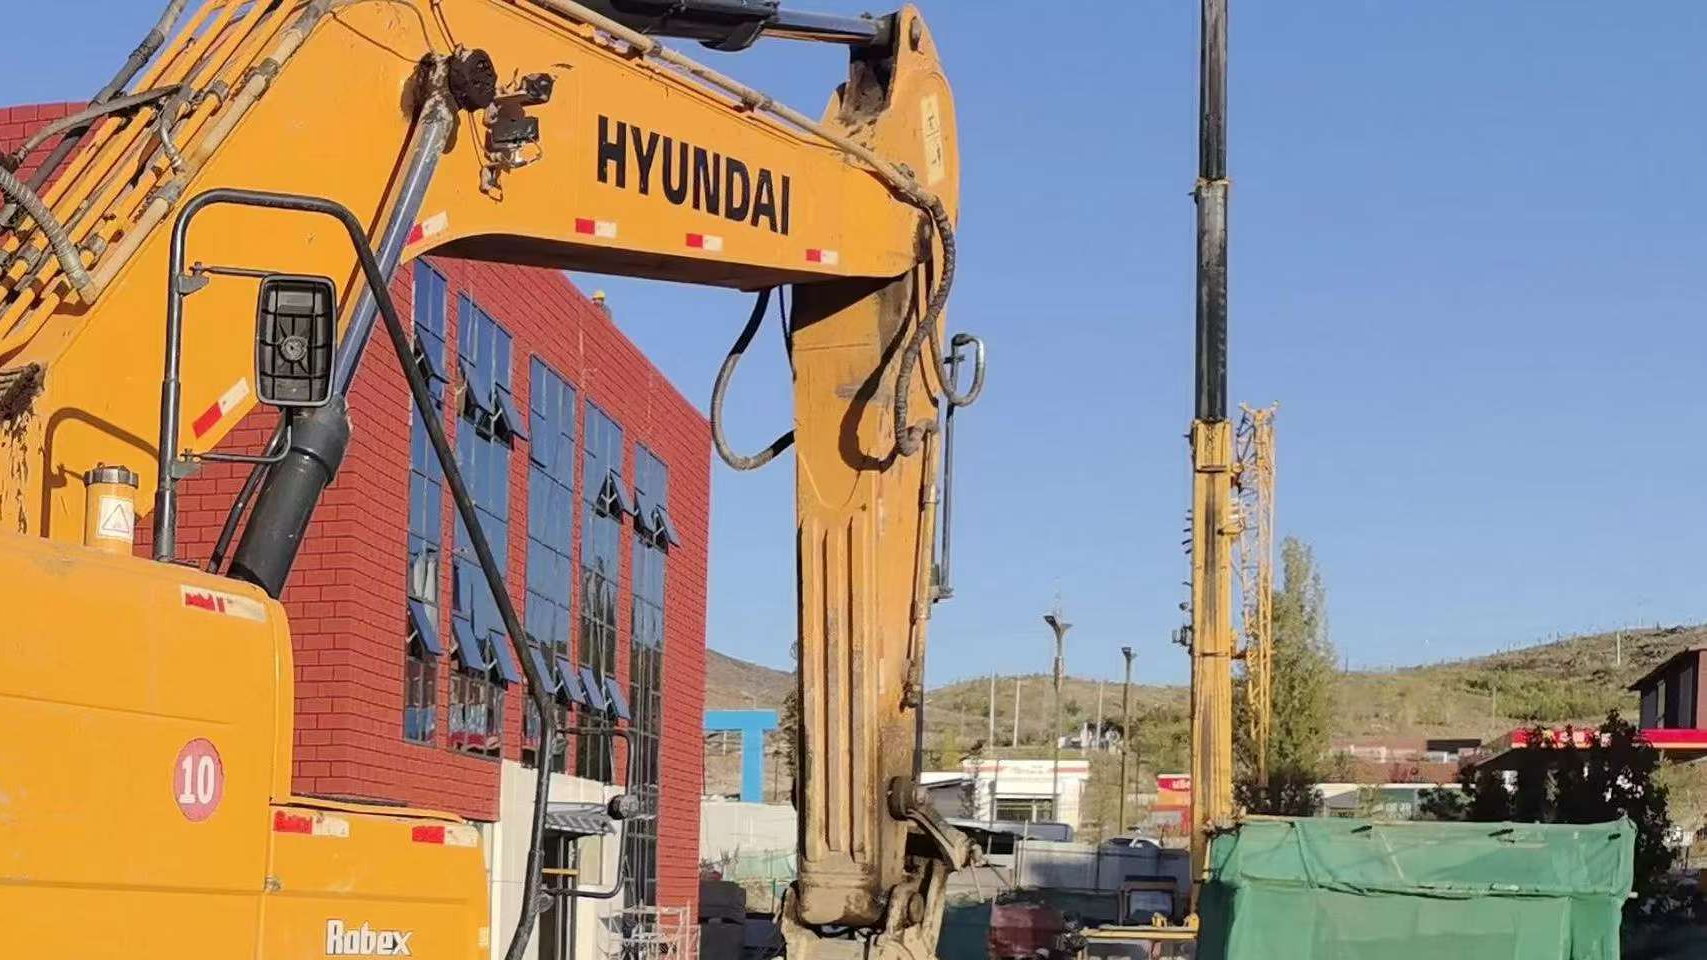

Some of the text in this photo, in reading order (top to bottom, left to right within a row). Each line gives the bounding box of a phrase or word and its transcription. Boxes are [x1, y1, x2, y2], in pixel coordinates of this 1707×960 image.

[597, 114, 790, 236] HYUNDAI
[178, 754, 215, 804] 10
[326, 918, 413, 957] Robex
